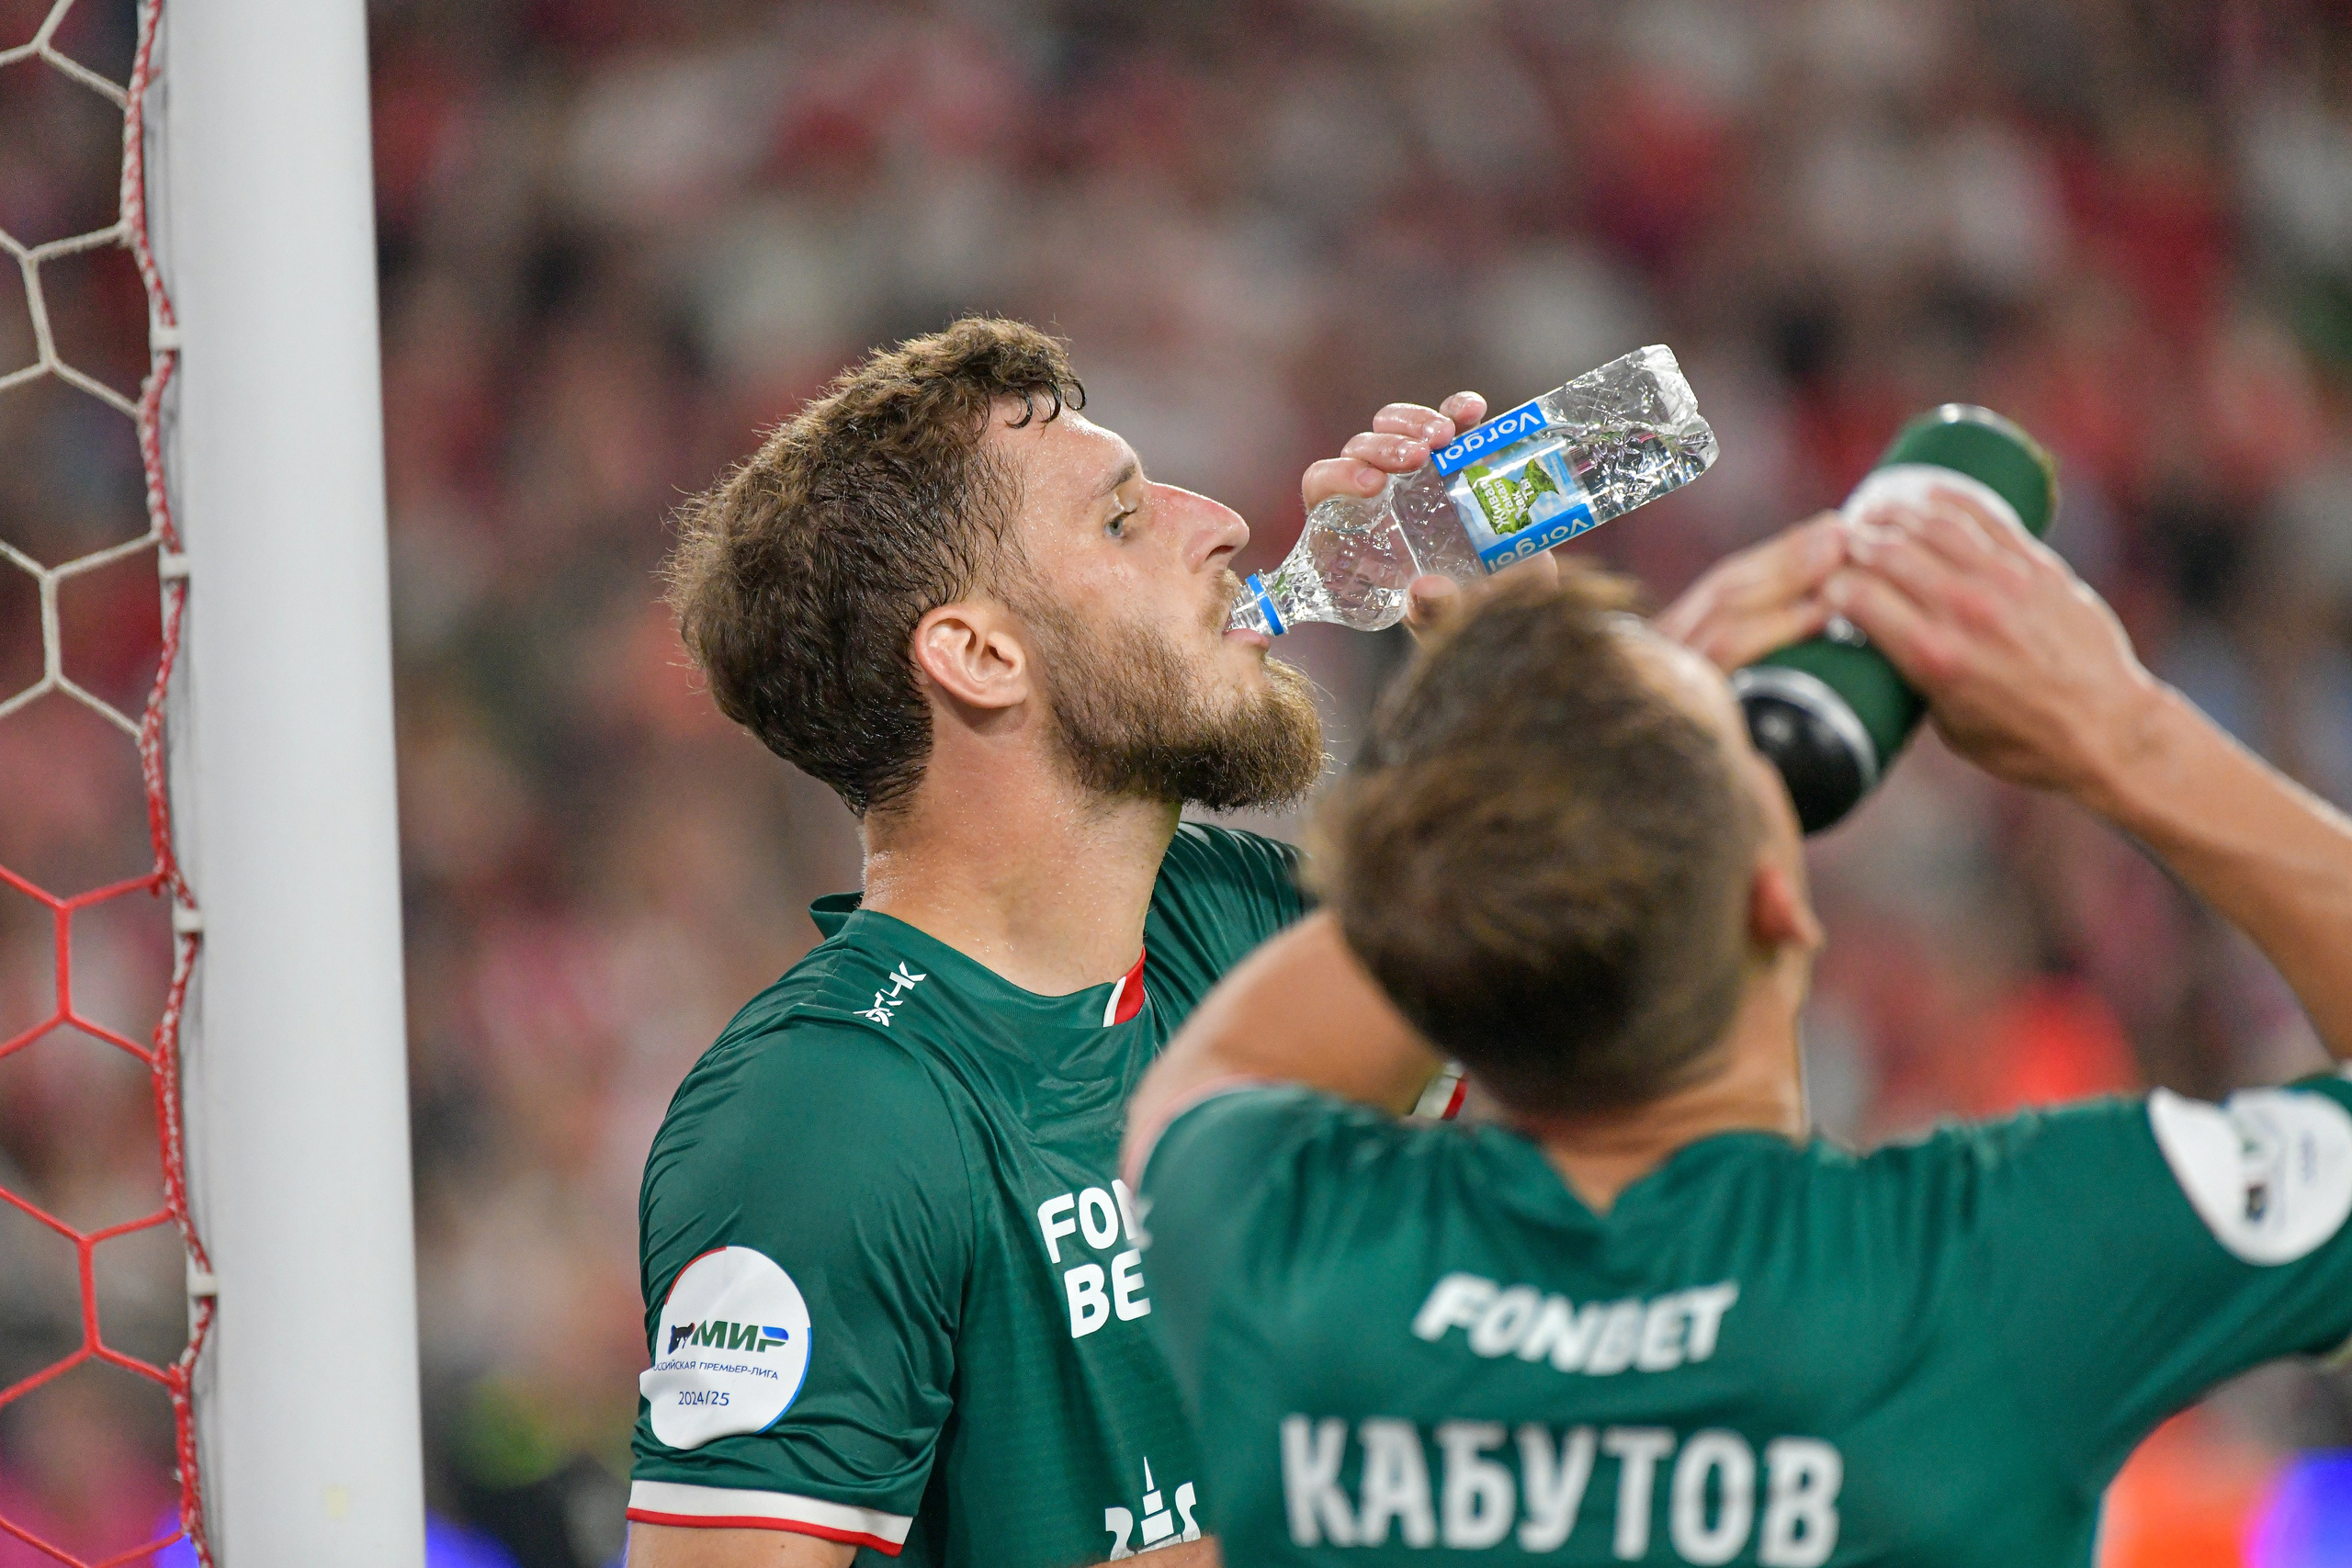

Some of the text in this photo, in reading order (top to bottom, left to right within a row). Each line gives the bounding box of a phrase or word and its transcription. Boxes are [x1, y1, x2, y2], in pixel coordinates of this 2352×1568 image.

[1436, 412, 1541, 469] Vorgol
[1480, 480, 1510, 528] Живая
[1494, 479, 1516, 514] такая
[1520, 479, 1534, 500] Ты
[1487, 518, 1589, 571] Vorgol
[690, 1319, 789, 1354] МИР
[1411, 1271, 1739, 1375] FONBET
[653, 1359, 778, 1380] ОССИЙСКАЯ ПРЕМЬЕР-ЛИГА
[678, 1391, 729, 1406] 2024/25
[1281, 1414, 1843, 1568] КАБУТОВ
